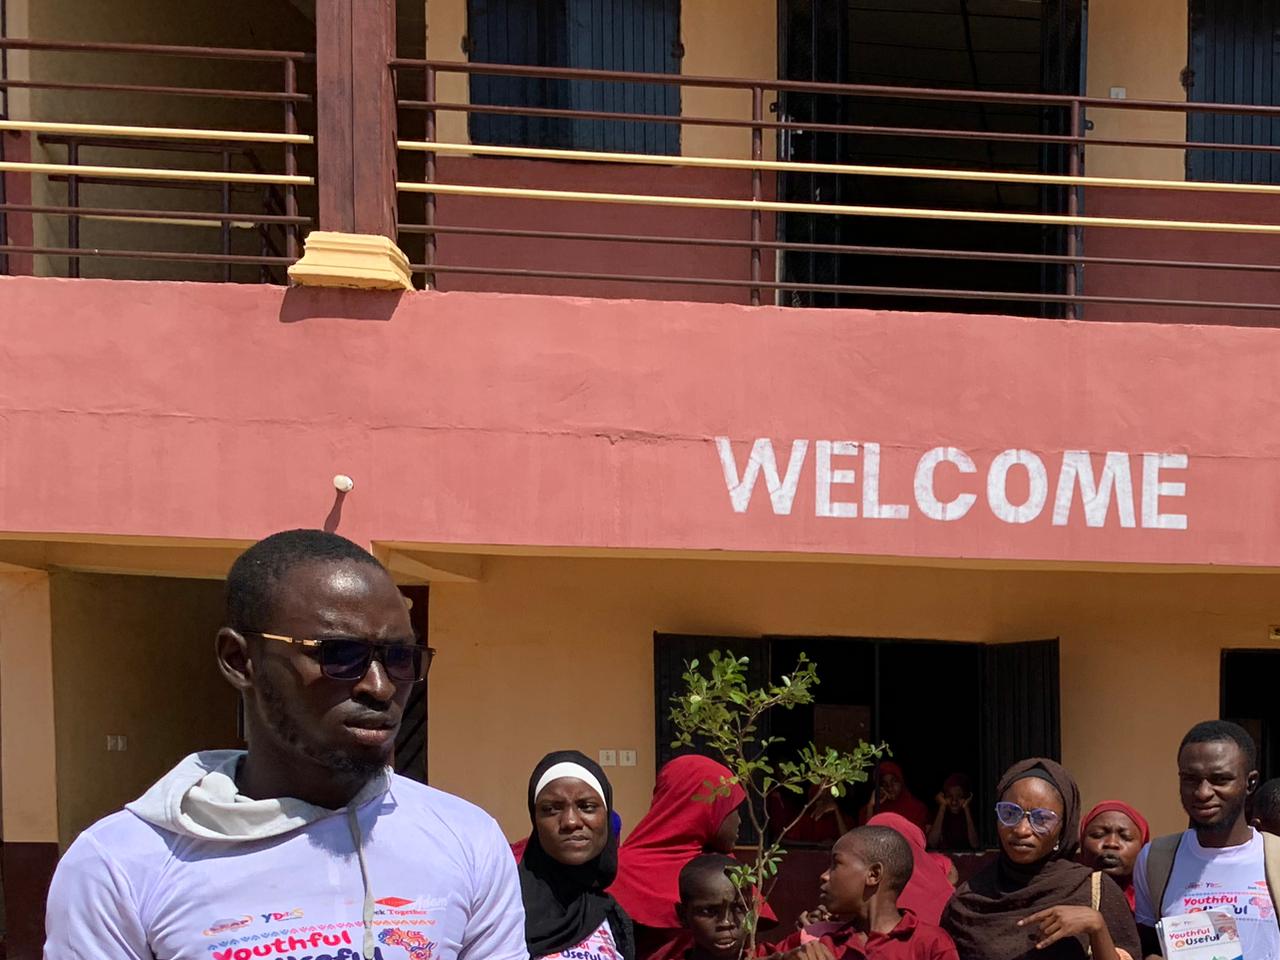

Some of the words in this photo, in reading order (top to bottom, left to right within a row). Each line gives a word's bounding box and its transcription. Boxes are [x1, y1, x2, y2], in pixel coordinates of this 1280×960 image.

[715, 436, 1188, 529] WELCOME
[1184, 895, 1238, 906] Youthful
[1169, 928, 1211, 940] Youthful
[1186, 934, 1220, 946] Useful
